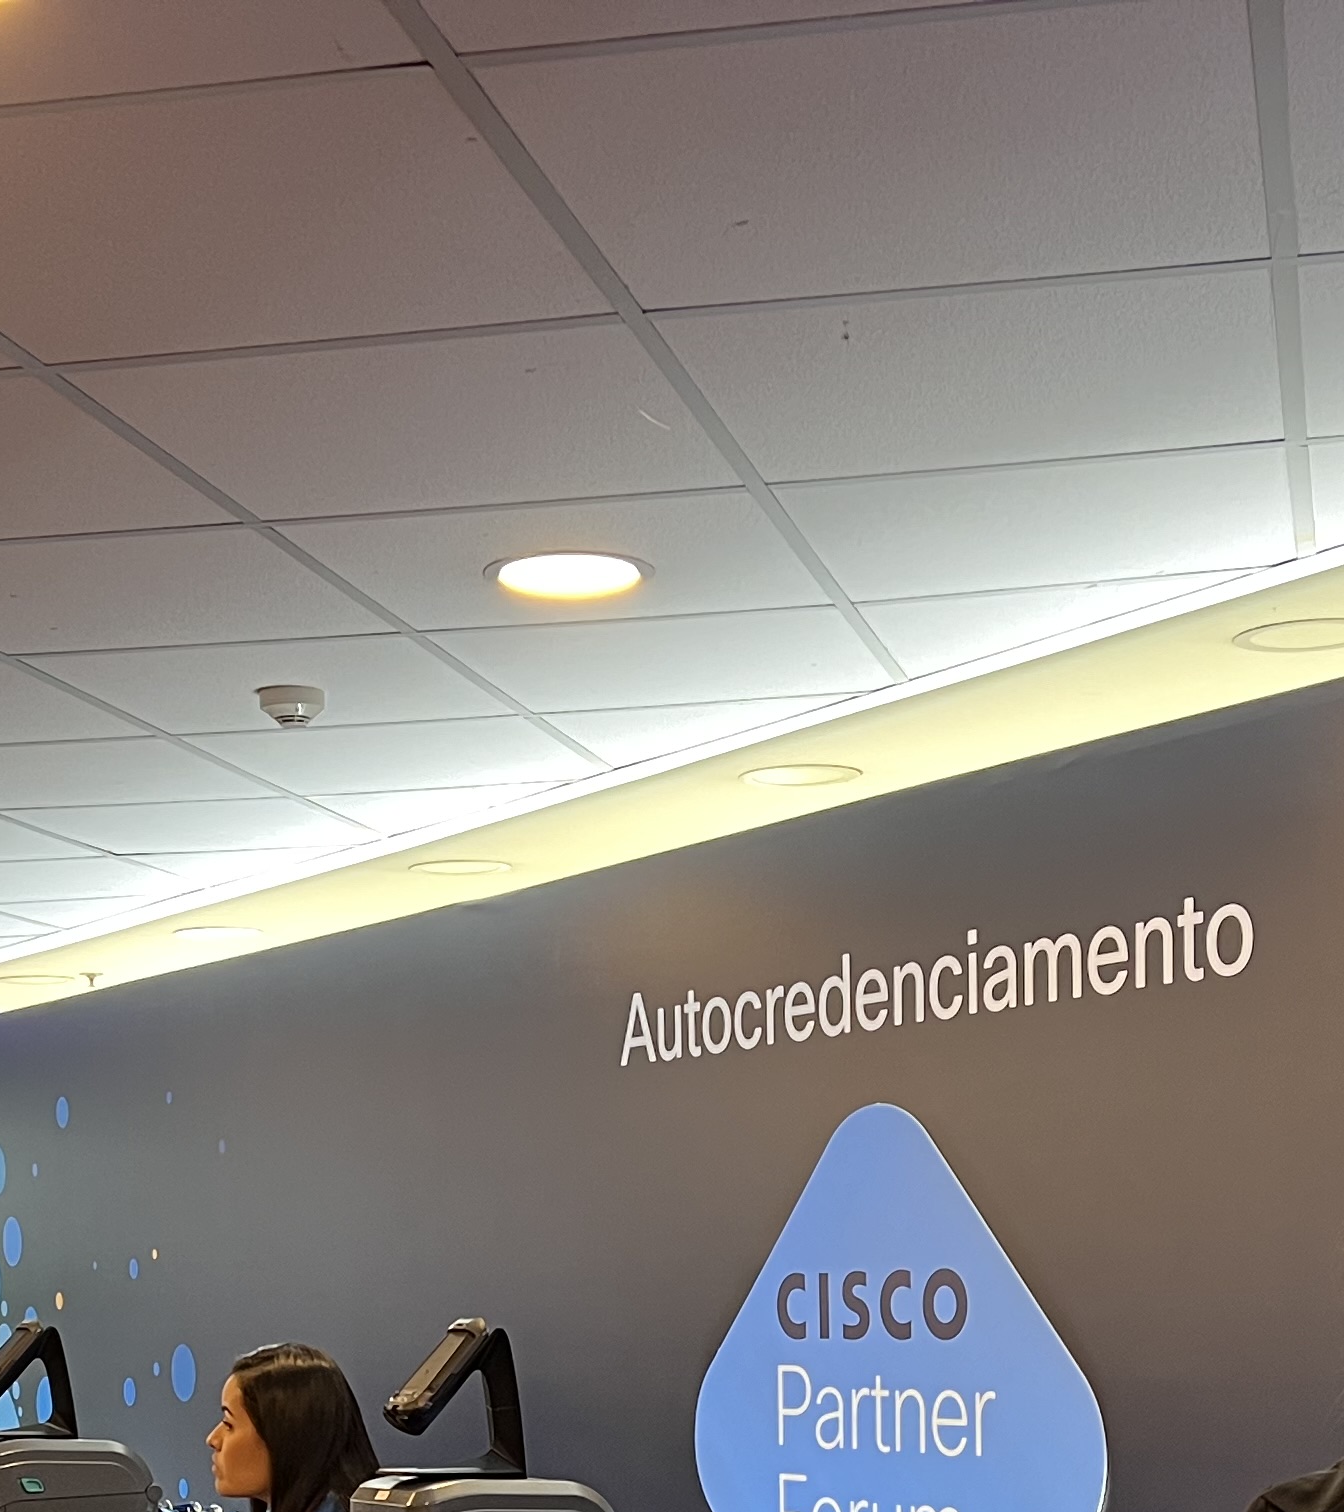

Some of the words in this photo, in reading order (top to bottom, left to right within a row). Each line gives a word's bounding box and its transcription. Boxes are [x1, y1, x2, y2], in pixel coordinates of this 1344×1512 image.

[620, 897, 1254, 1066] Autocredenciamento
[777, 1268, 968, 1341] CISCO
[777, 1364, 996, 1457] Partner
